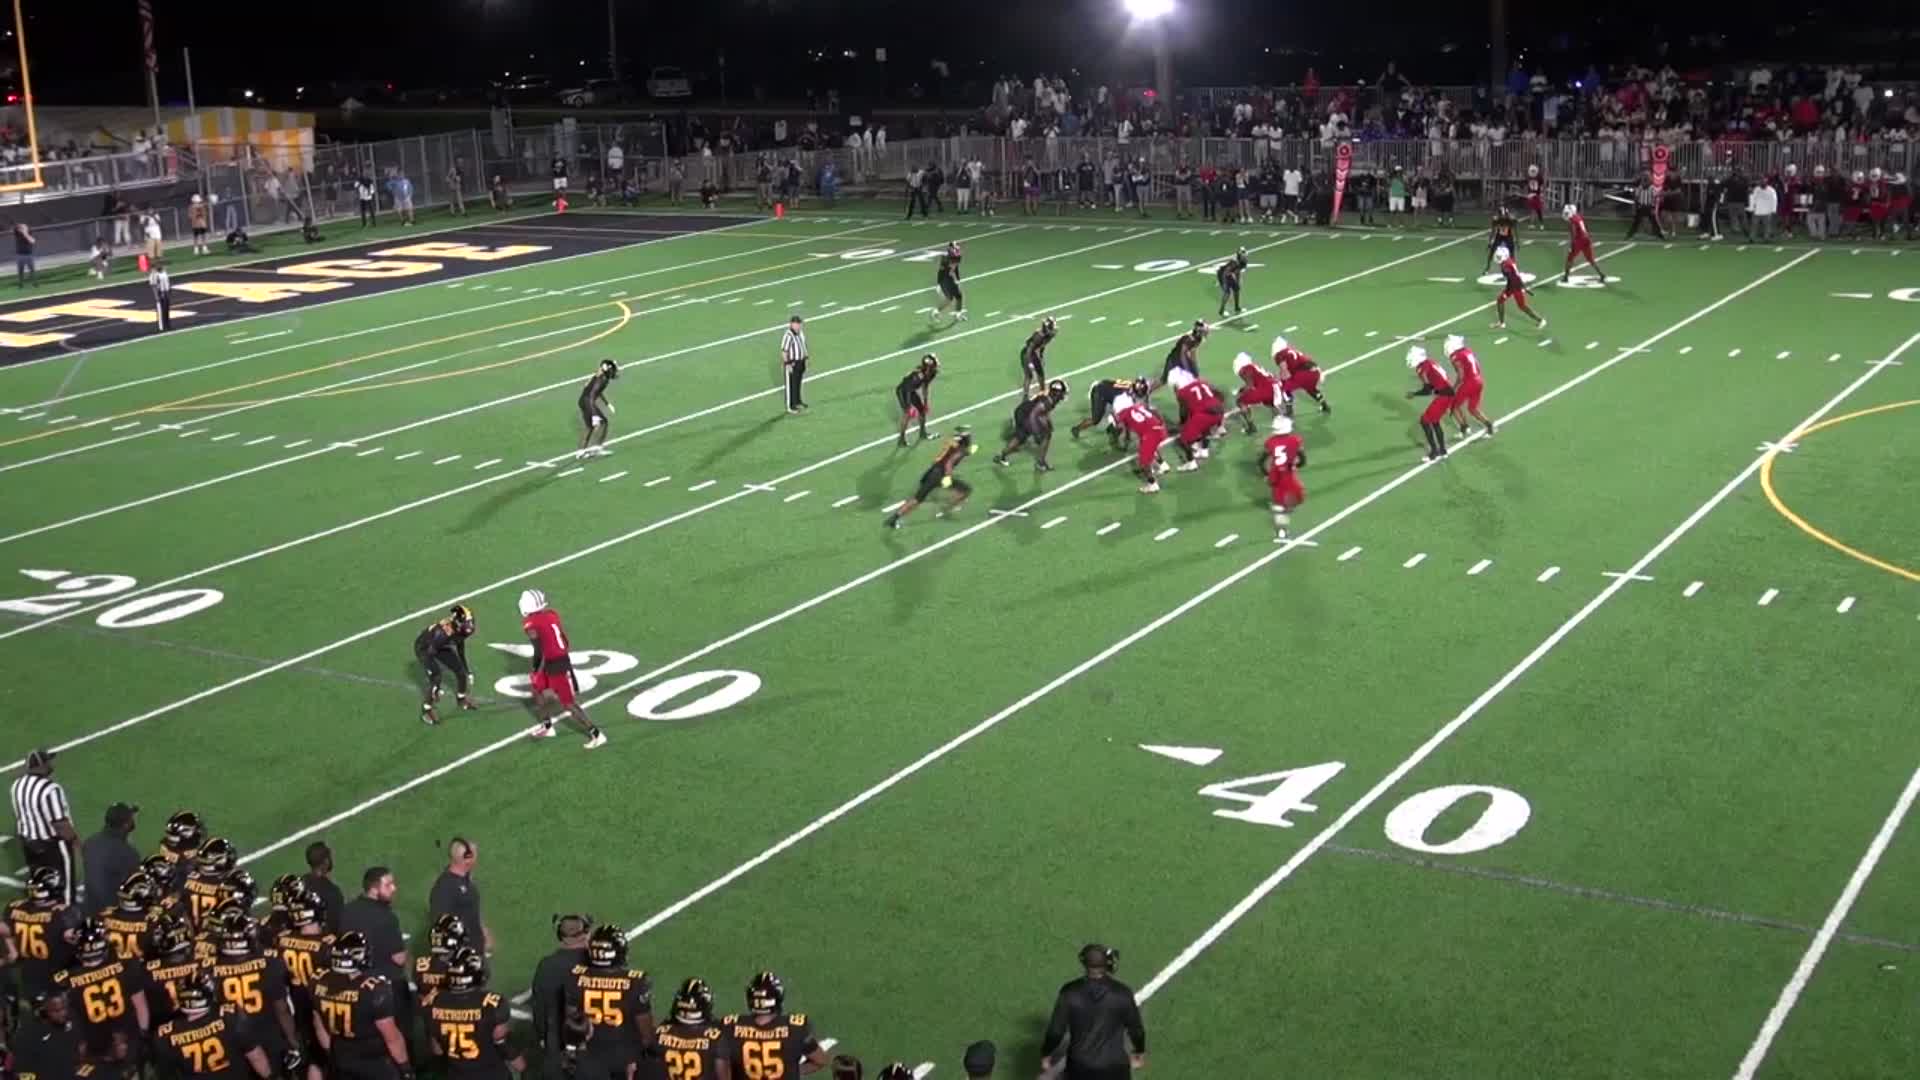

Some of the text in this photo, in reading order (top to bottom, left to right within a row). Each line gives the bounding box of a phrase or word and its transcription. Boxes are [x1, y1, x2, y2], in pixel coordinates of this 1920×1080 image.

[1274, 445, 1287, 466] 5
[551, 623, 566, 650] 1
[1198, 761, 1531, 854] 40
[15, 922, 49, 960] 76
[69, 962, 125, 988] PATRIOTS
[152, 963, 199, 981] PATRIOT
[213, 958, 268, 977] PATRIOTS
[223, 973, 264, 1014] 95
[577, 975, 632, 990] PATRIOTS
[83, 978, 126, 1023] 63
[431, 1008, 482, 1021] PATRIOTS
[584, 989, 624, 1027] 55
[320, 999, 356, 1037] 77
[734, 1025, 790, 1039] PATRIOTS
[170, 1019, 226, 1047] PATRIOTS
[440, 1022, 480, 1060] 75
[658, 1032, 711, 1051] PATRIOTS
[181, 1037, 232, 1073] 72
[664, 1050, 702, 1080] 22
[742, 1041, 785, 1080] 65
